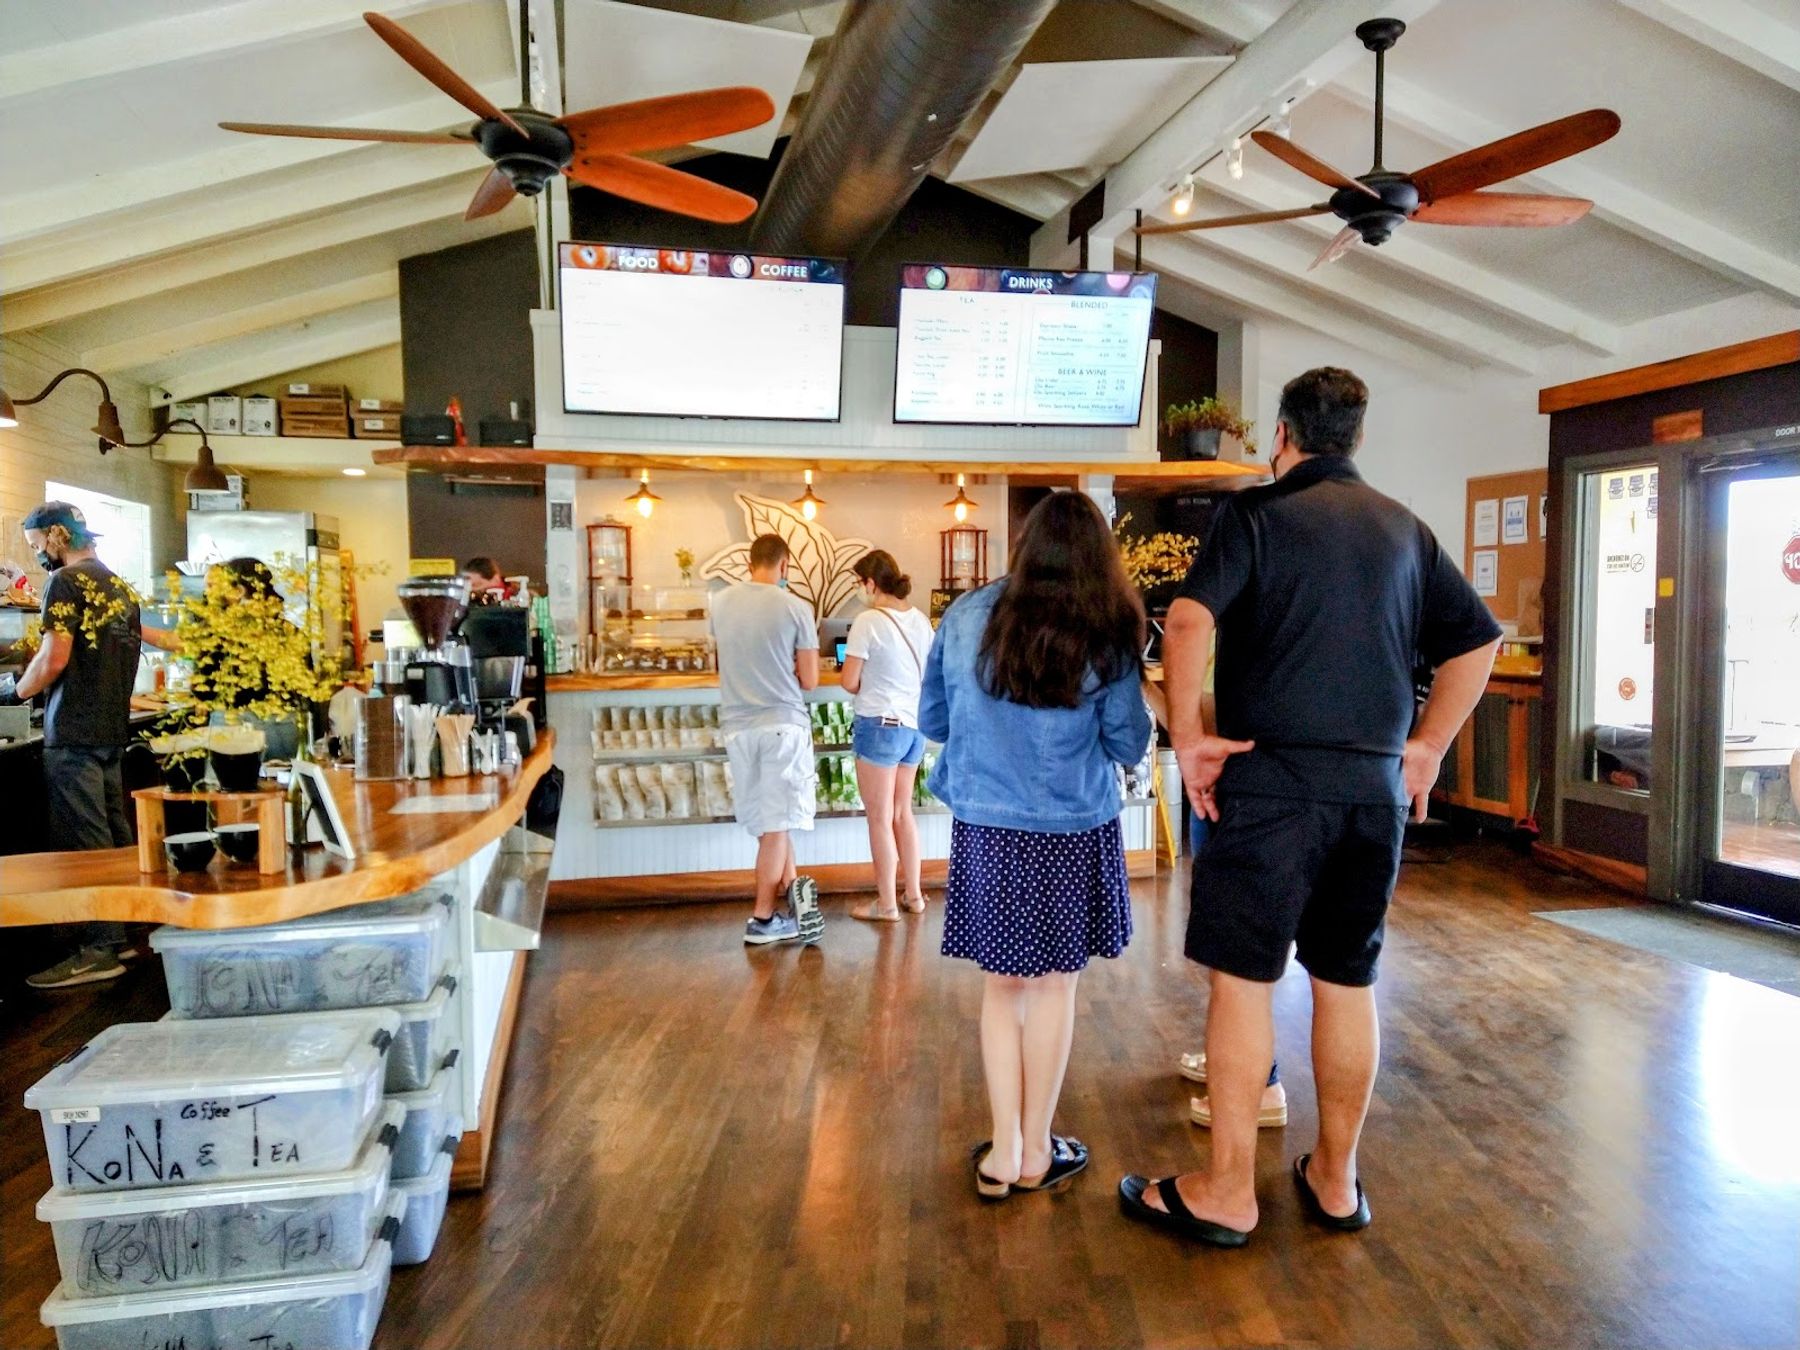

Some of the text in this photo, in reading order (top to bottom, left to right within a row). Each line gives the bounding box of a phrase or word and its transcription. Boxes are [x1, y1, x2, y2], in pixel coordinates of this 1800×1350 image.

[618, 255, 659, 269] FOOD
[760, 264, 808, 278] COFFEE
[1008, 276, 1054, 290] DRINKS
[959, 296, 975, 304] TEA
[1070, 300, 1109, 310] BLENDED
[1057, 367, 1077, 376] BEER
[1086, 369, 1108, 377] WINE
[1775, 424, 1796, 437] DOOR
[181, 1102, 231, 1120] Coffee
